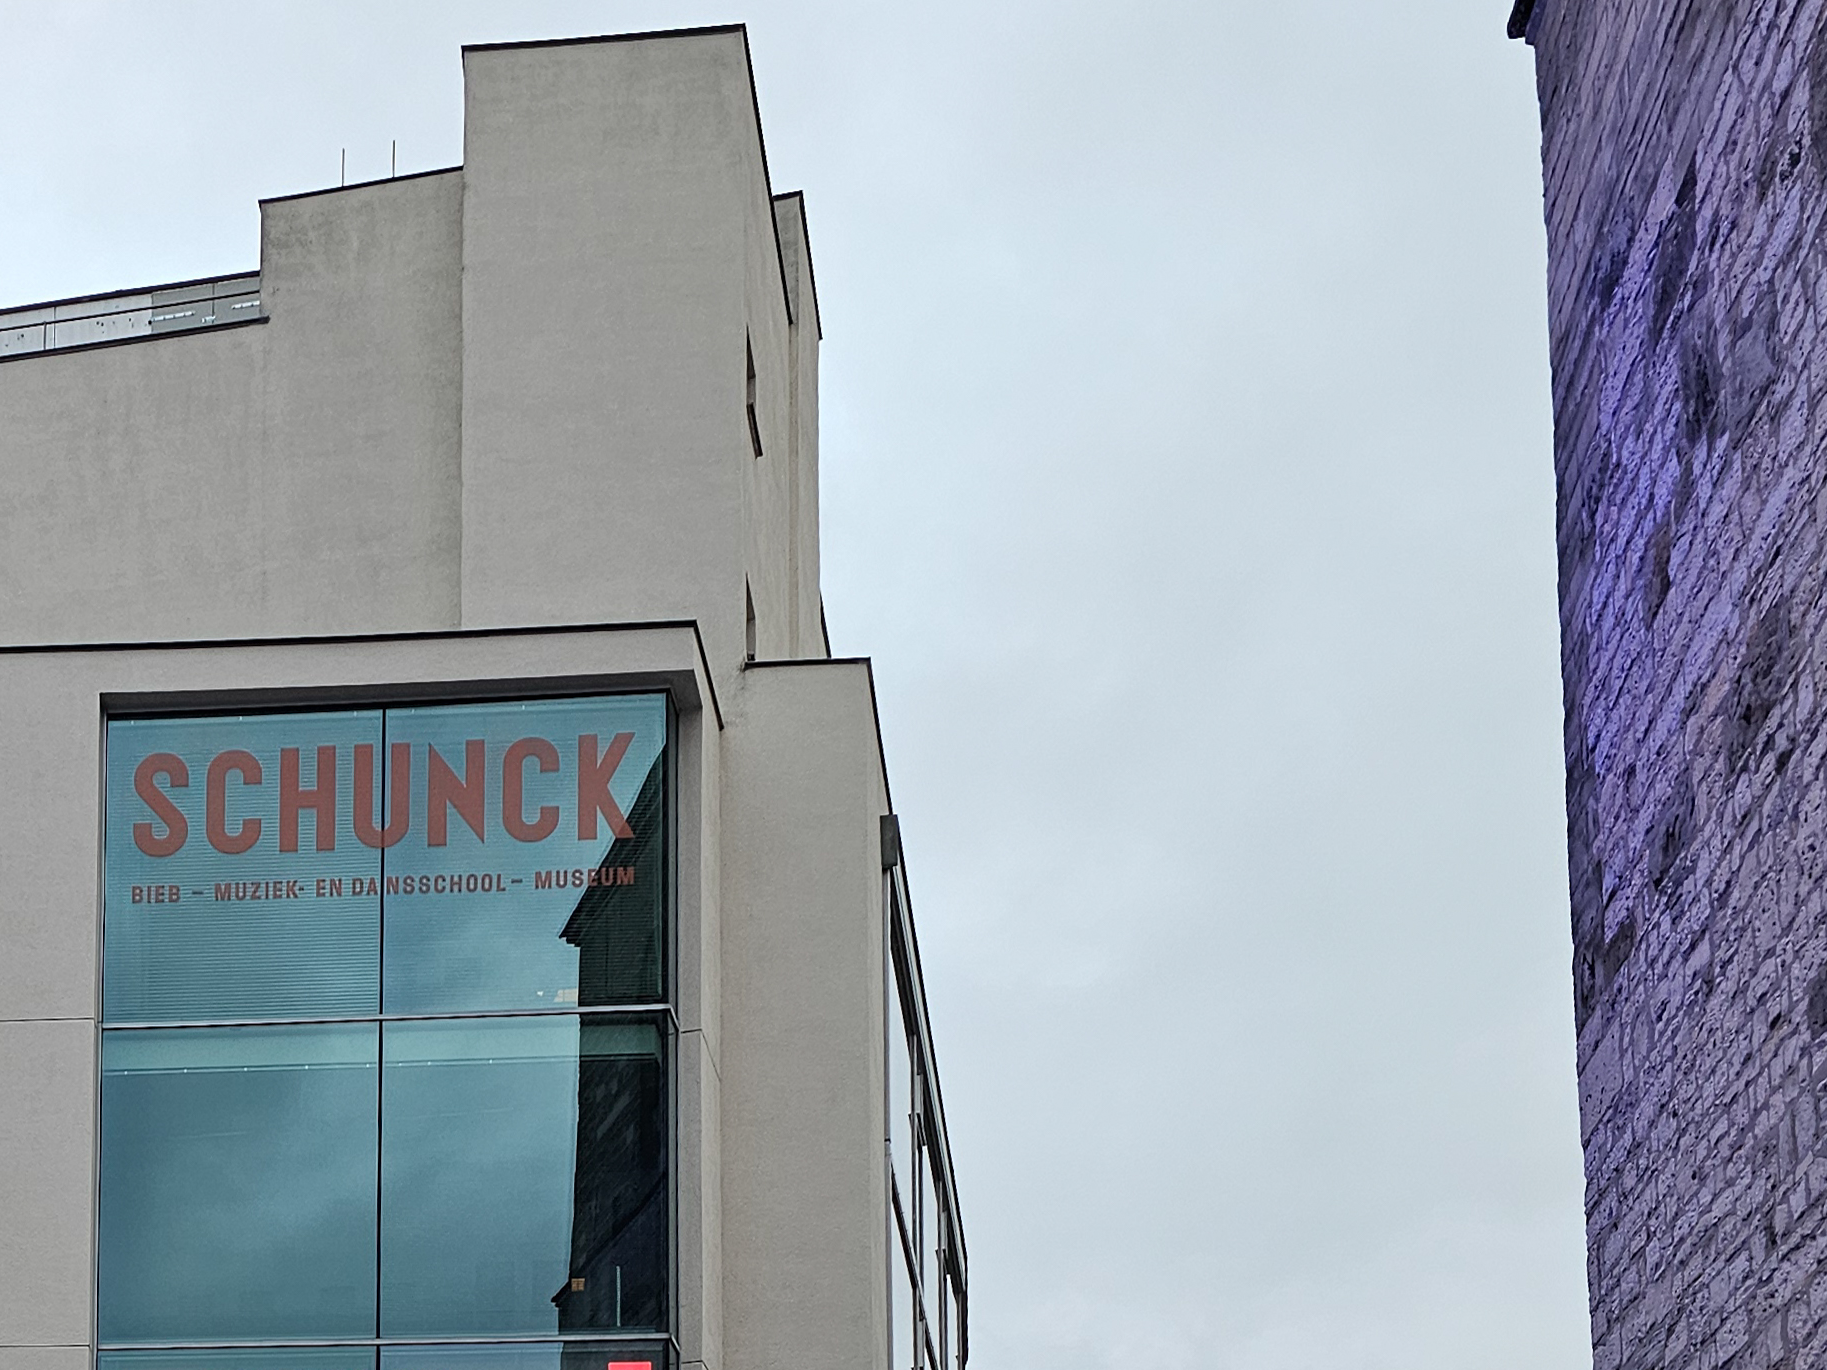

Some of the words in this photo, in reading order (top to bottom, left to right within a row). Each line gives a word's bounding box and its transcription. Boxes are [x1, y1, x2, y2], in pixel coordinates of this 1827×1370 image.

[132, 731, 636, 857] SCHUNCK
[131, 885, 181, 904] BIEB
[315, 878, 343, 898] EN
[534, 867, 636, 889] MUSEUM
